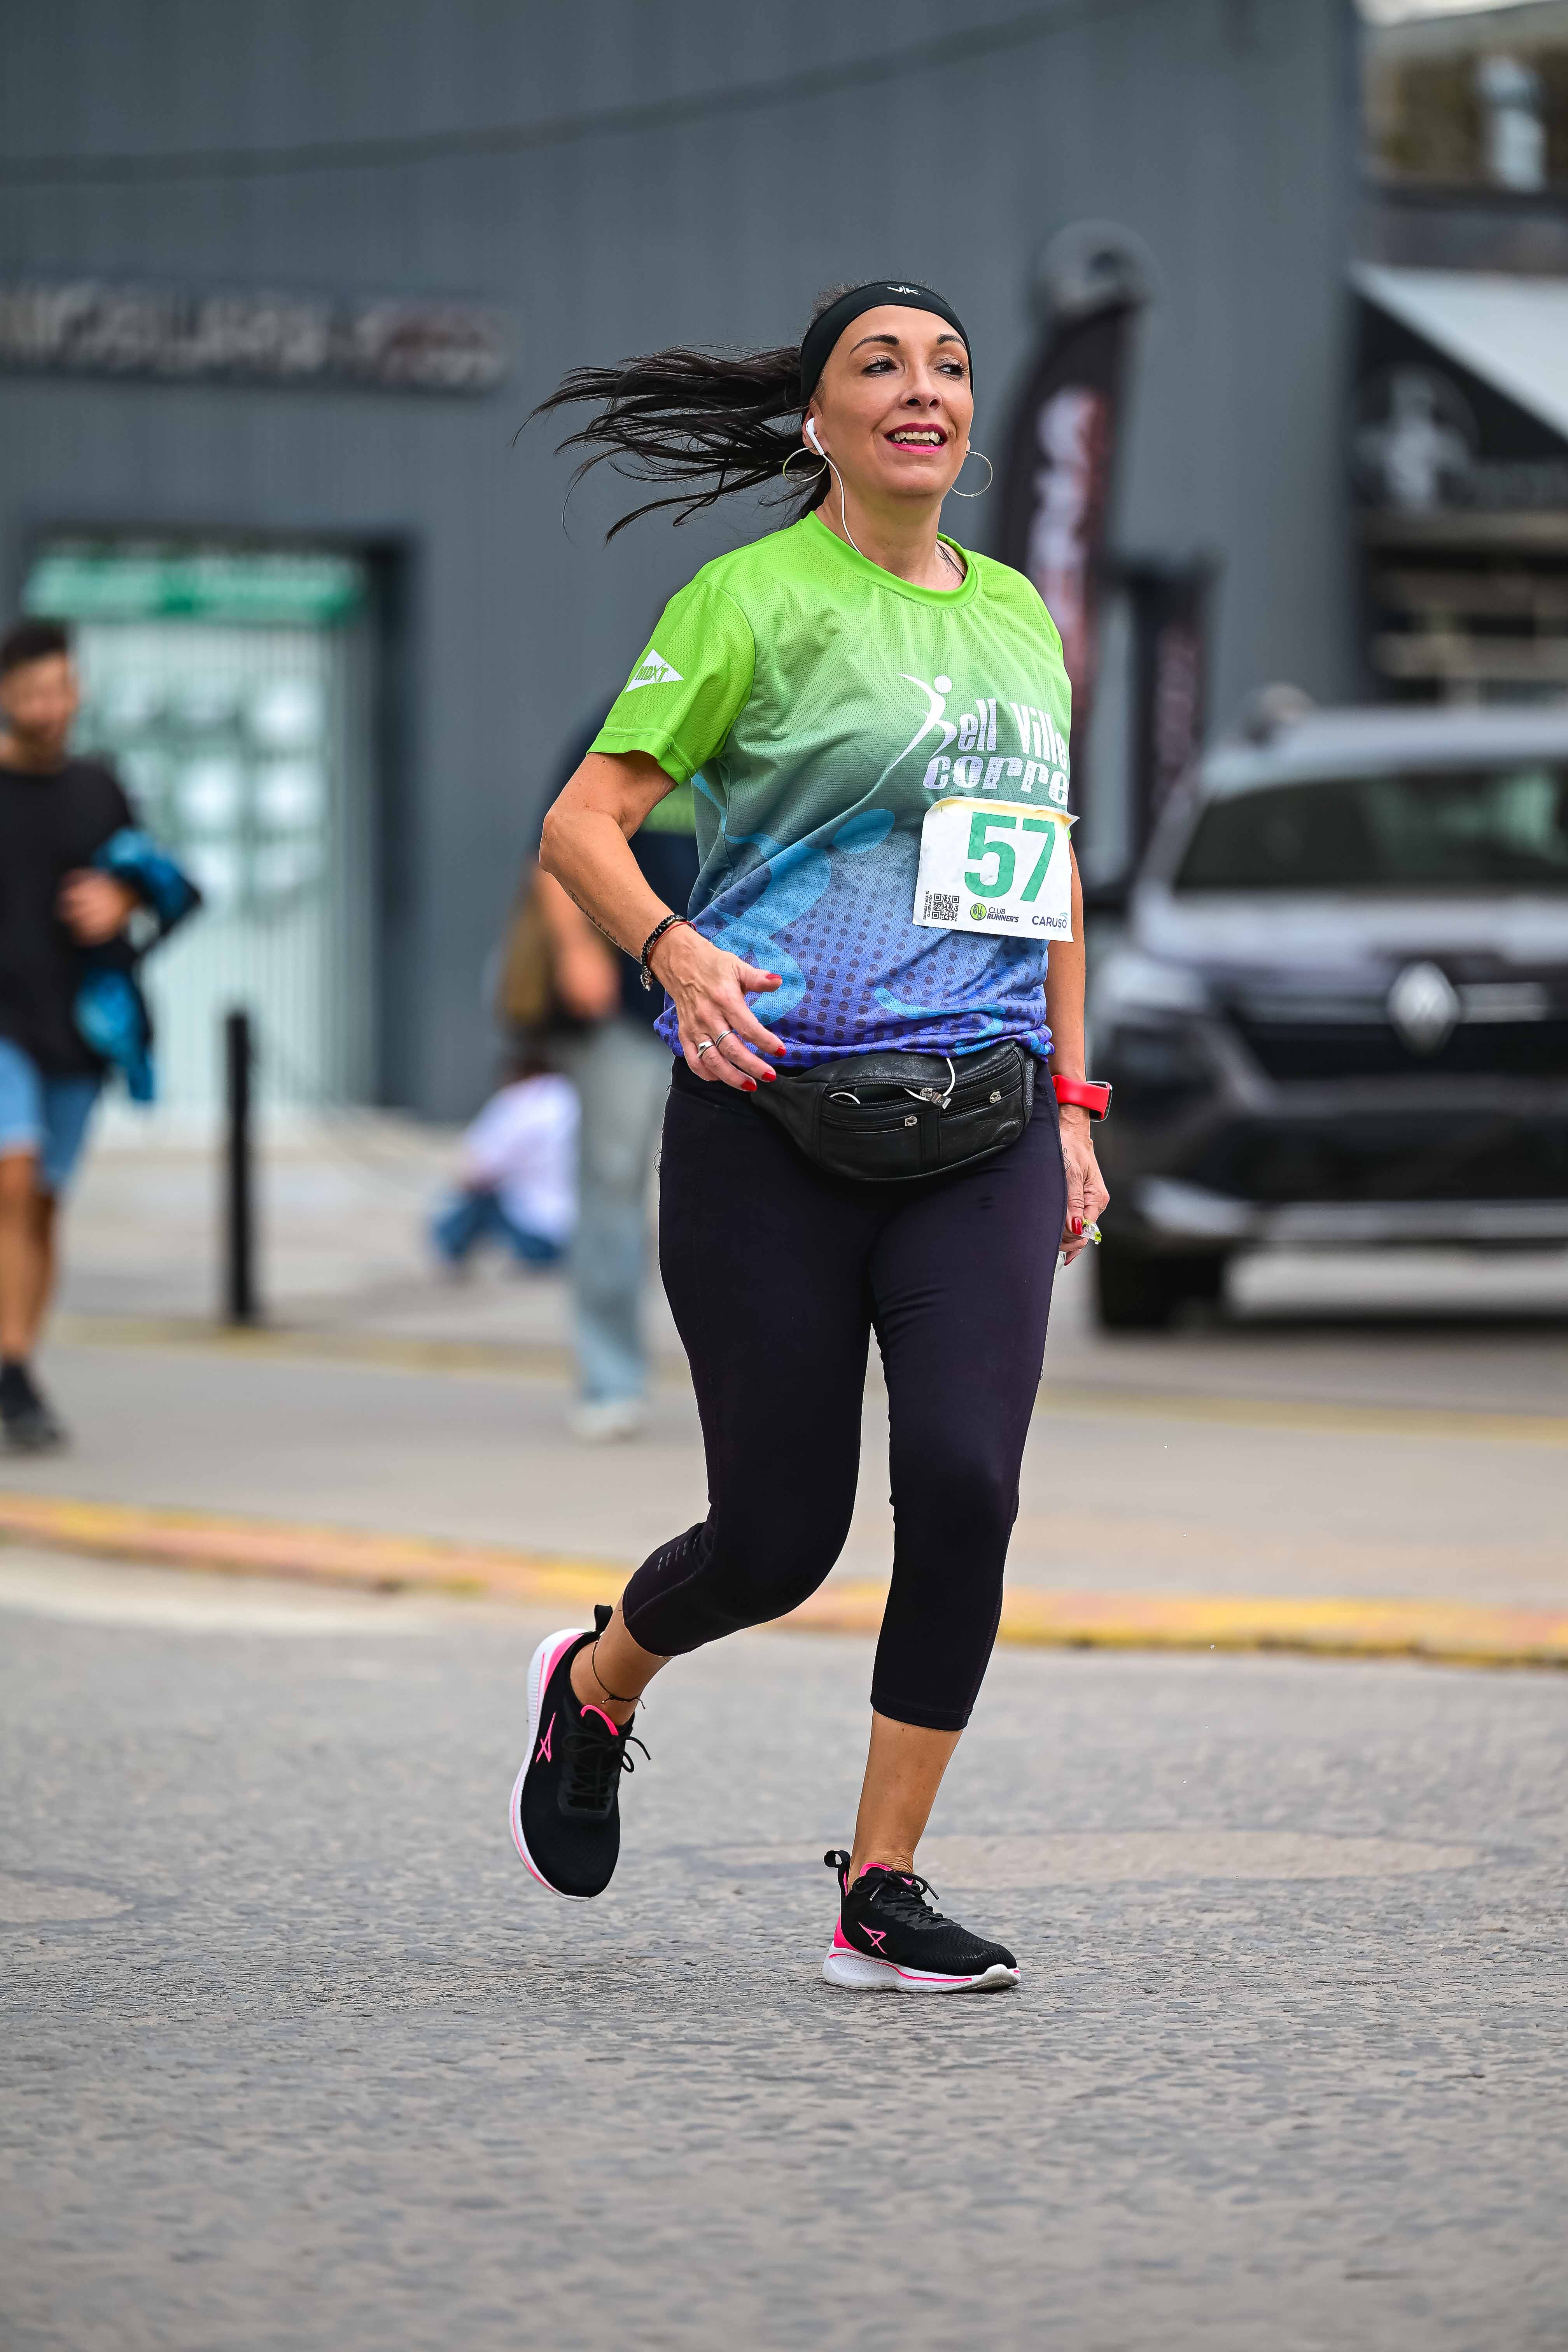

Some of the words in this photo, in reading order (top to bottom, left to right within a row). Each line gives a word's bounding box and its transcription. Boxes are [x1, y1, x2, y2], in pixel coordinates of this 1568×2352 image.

[1010, 702, 1068, 771] Ville
[923, 755, 1068, 806] corre
[964, 812, 1055, 902] 57
[987, 913, 1019, 923] RUNNER'S
[1032, 915, 1067, 928] CARUSO
